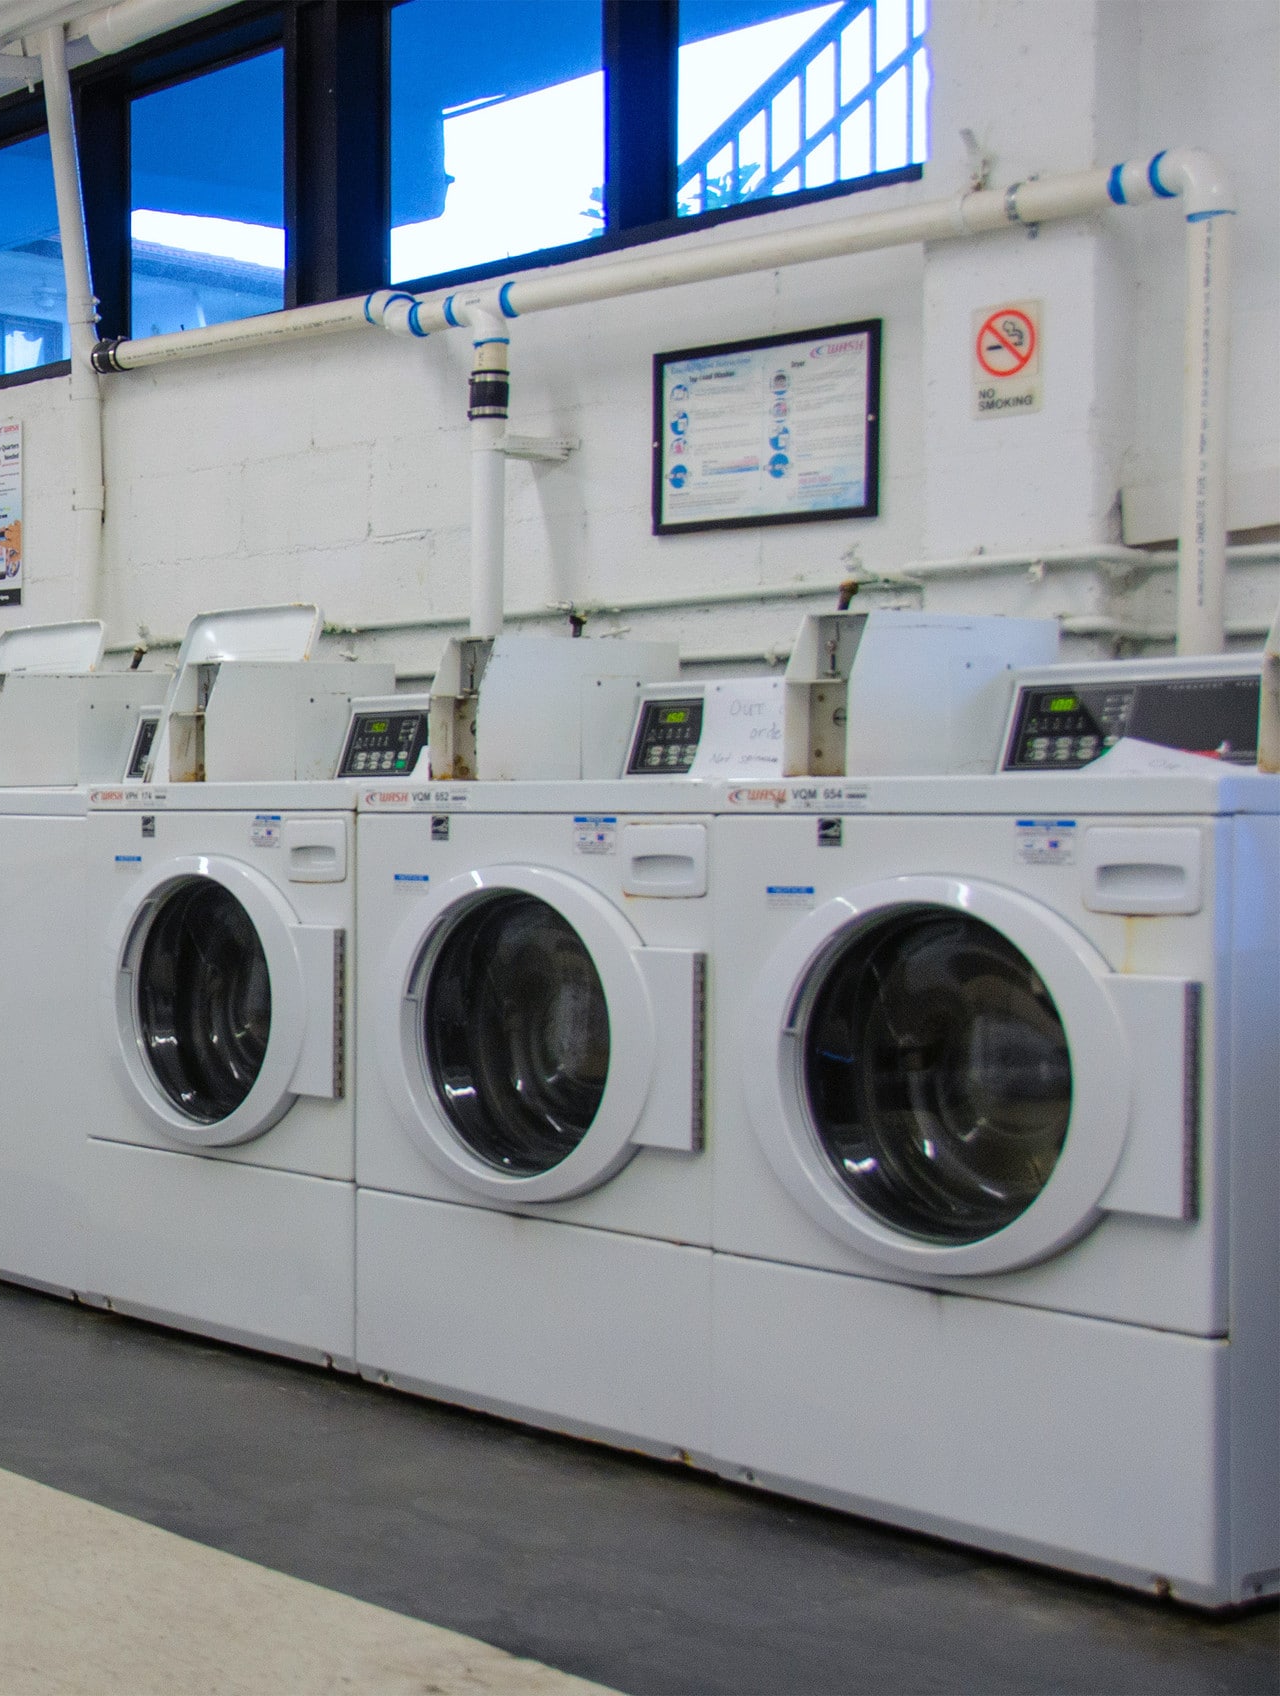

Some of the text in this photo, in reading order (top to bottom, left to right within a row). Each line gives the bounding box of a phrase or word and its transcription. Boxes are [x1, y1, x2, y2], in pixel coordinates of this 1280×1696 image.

[979, 388, 995, 399] NO
[979, 395, 1033, 412] SMOKING
[750, 722, 782, 740] orde
[380, 791, 408, 802] WASH
[747, 788, 786, 802] WASH
[792, 788, 817, 800] VQM
[823, 788, 842, 800] 654
